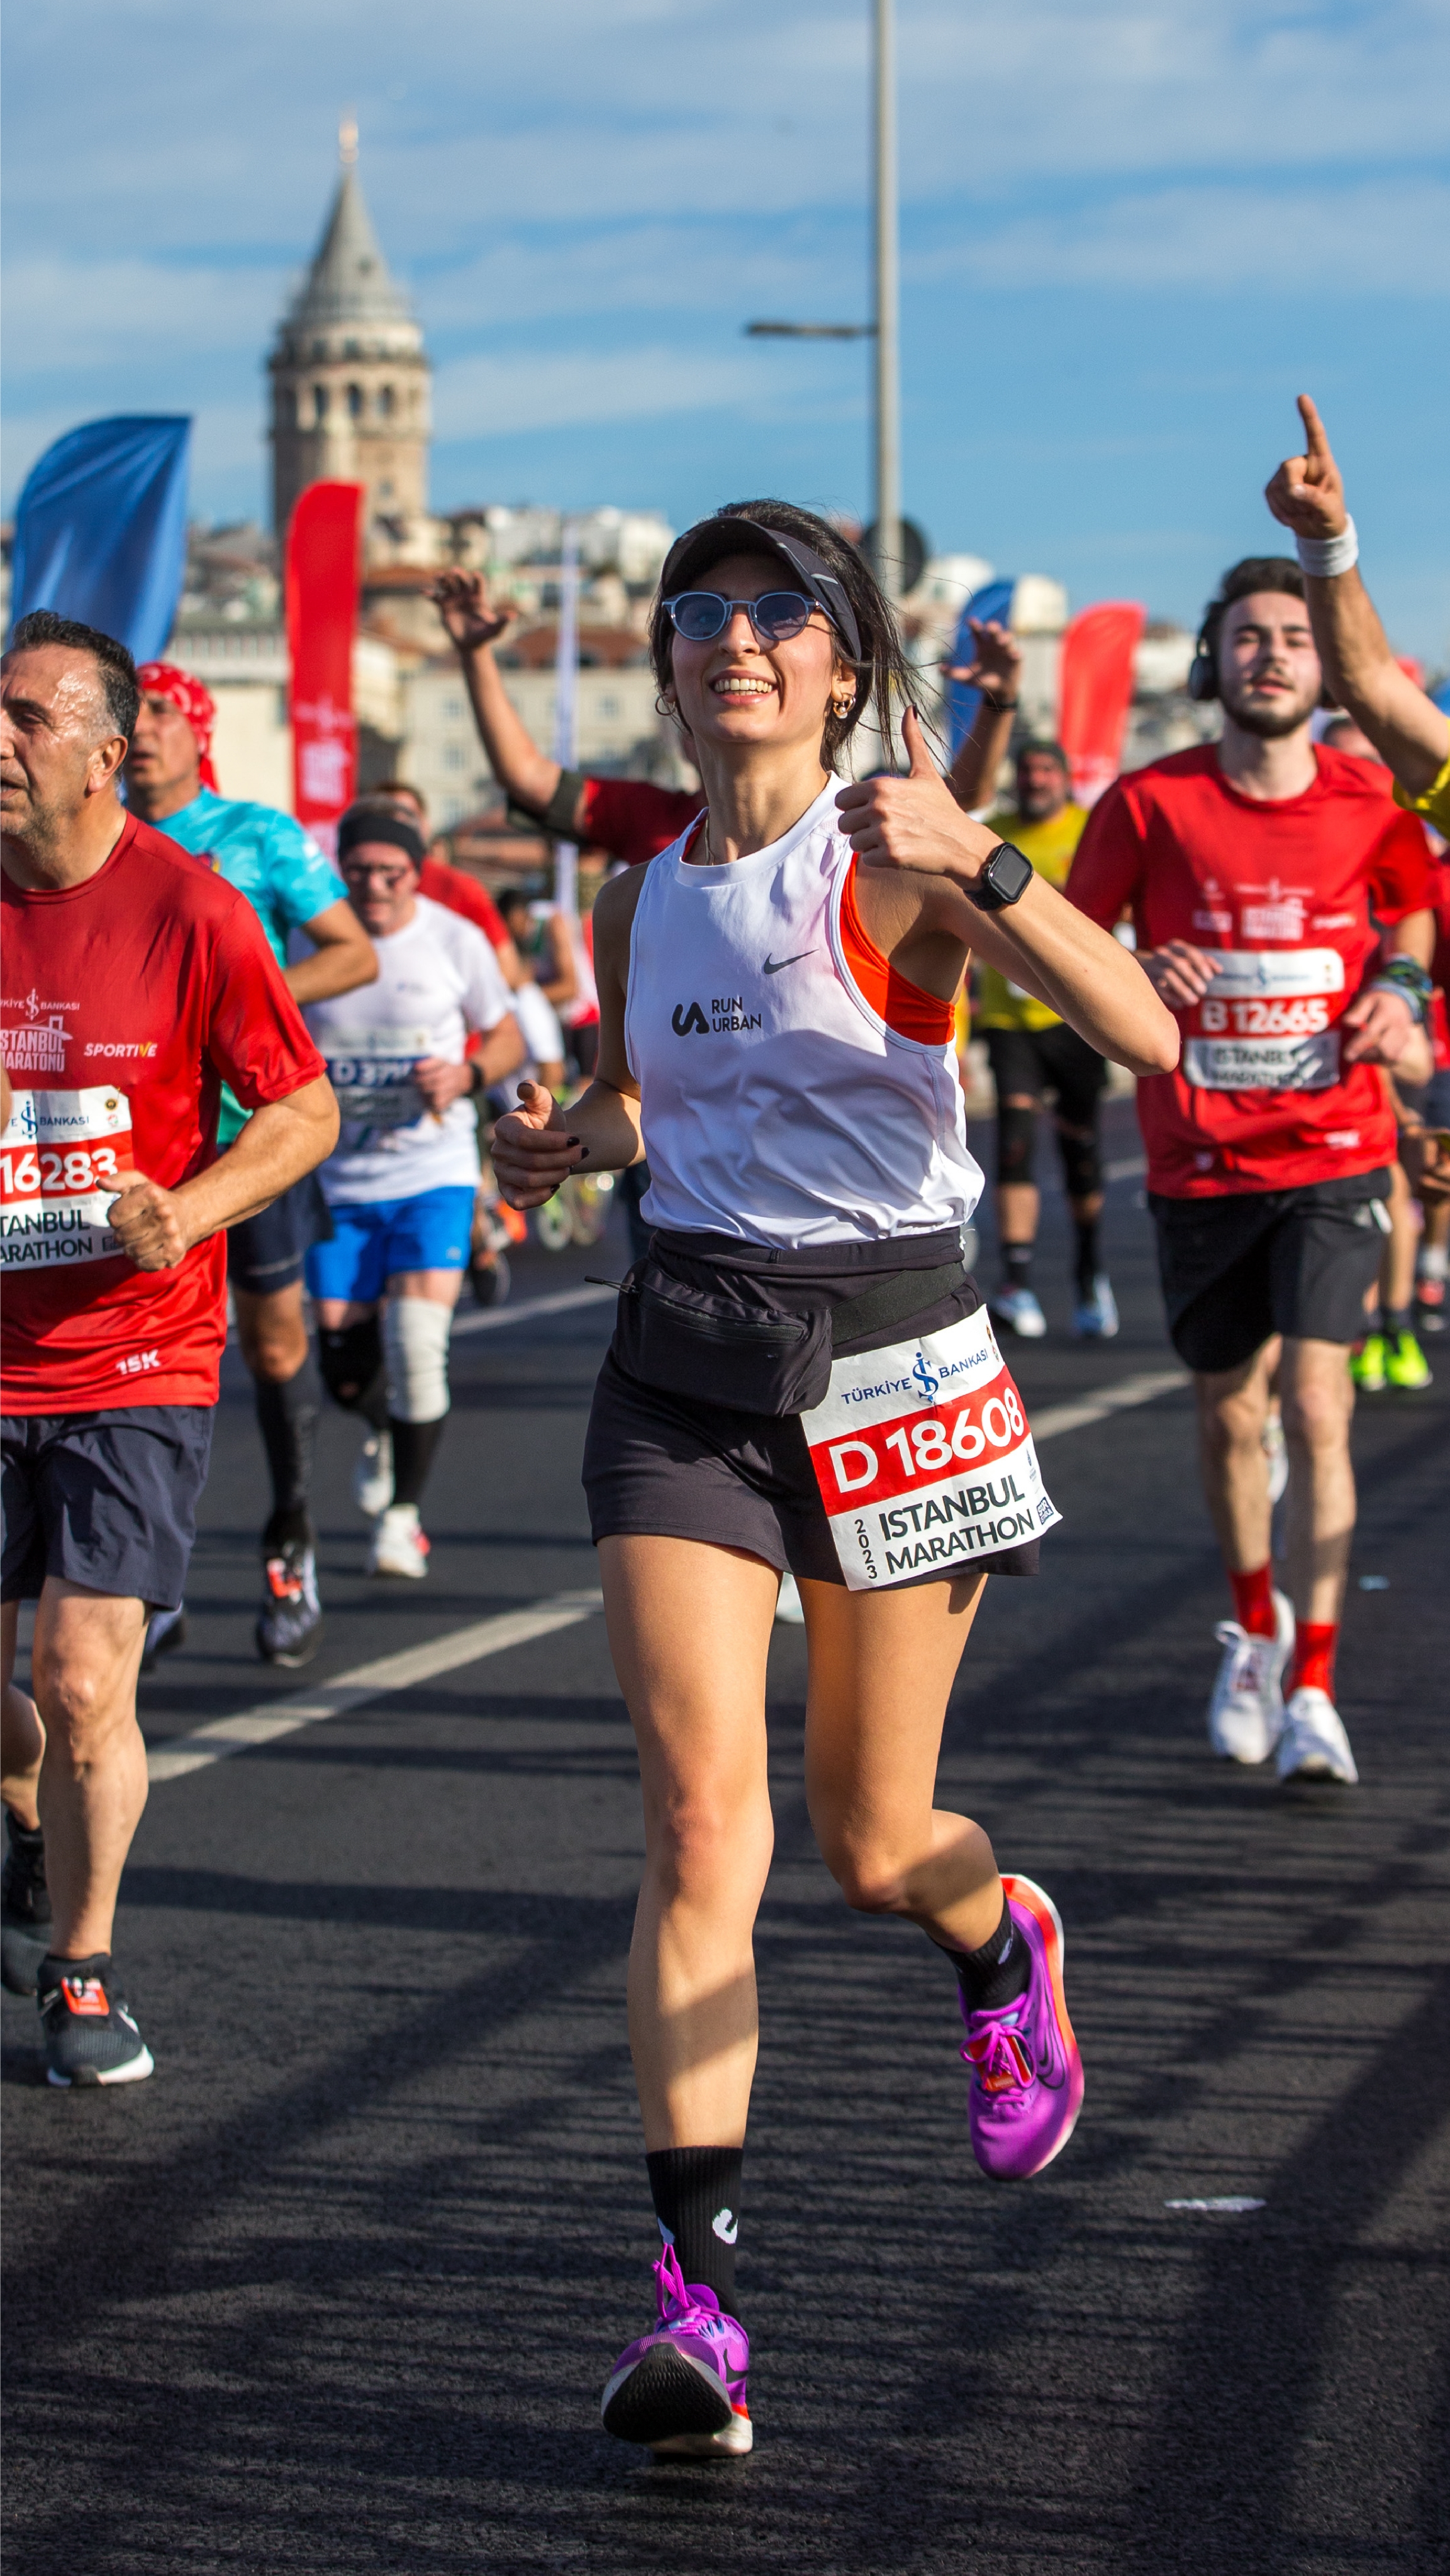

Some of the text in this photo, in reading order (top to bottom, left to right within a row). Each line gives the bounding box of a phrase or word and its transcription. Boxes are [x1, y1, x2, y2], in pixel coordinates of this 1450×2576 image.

[40, 1001, 80, 1011] BANKASI
[711, 996, 742, 1014] RUN
[1202, 998, 1329, 1034] B 12665
[712, 1013, 762, 1033] URBAN
[84, 1041, 157, 1057] SPORTIVE
[40, 1116, 89, 1126] BANKASI
[0, 1148, 118, 1194] 16283
[116, 1349, 161, 1375] 15K
[841, 1377, 913, 1404] TÜRKİYE
[938, 1348, 988, 1379] BANKASI
[828, 1387, 1024, 1493] D 18608
[878, 1475, 1025, 1541] ISTANBUL
[886, 1508, 1035, 1575] MARATHON
